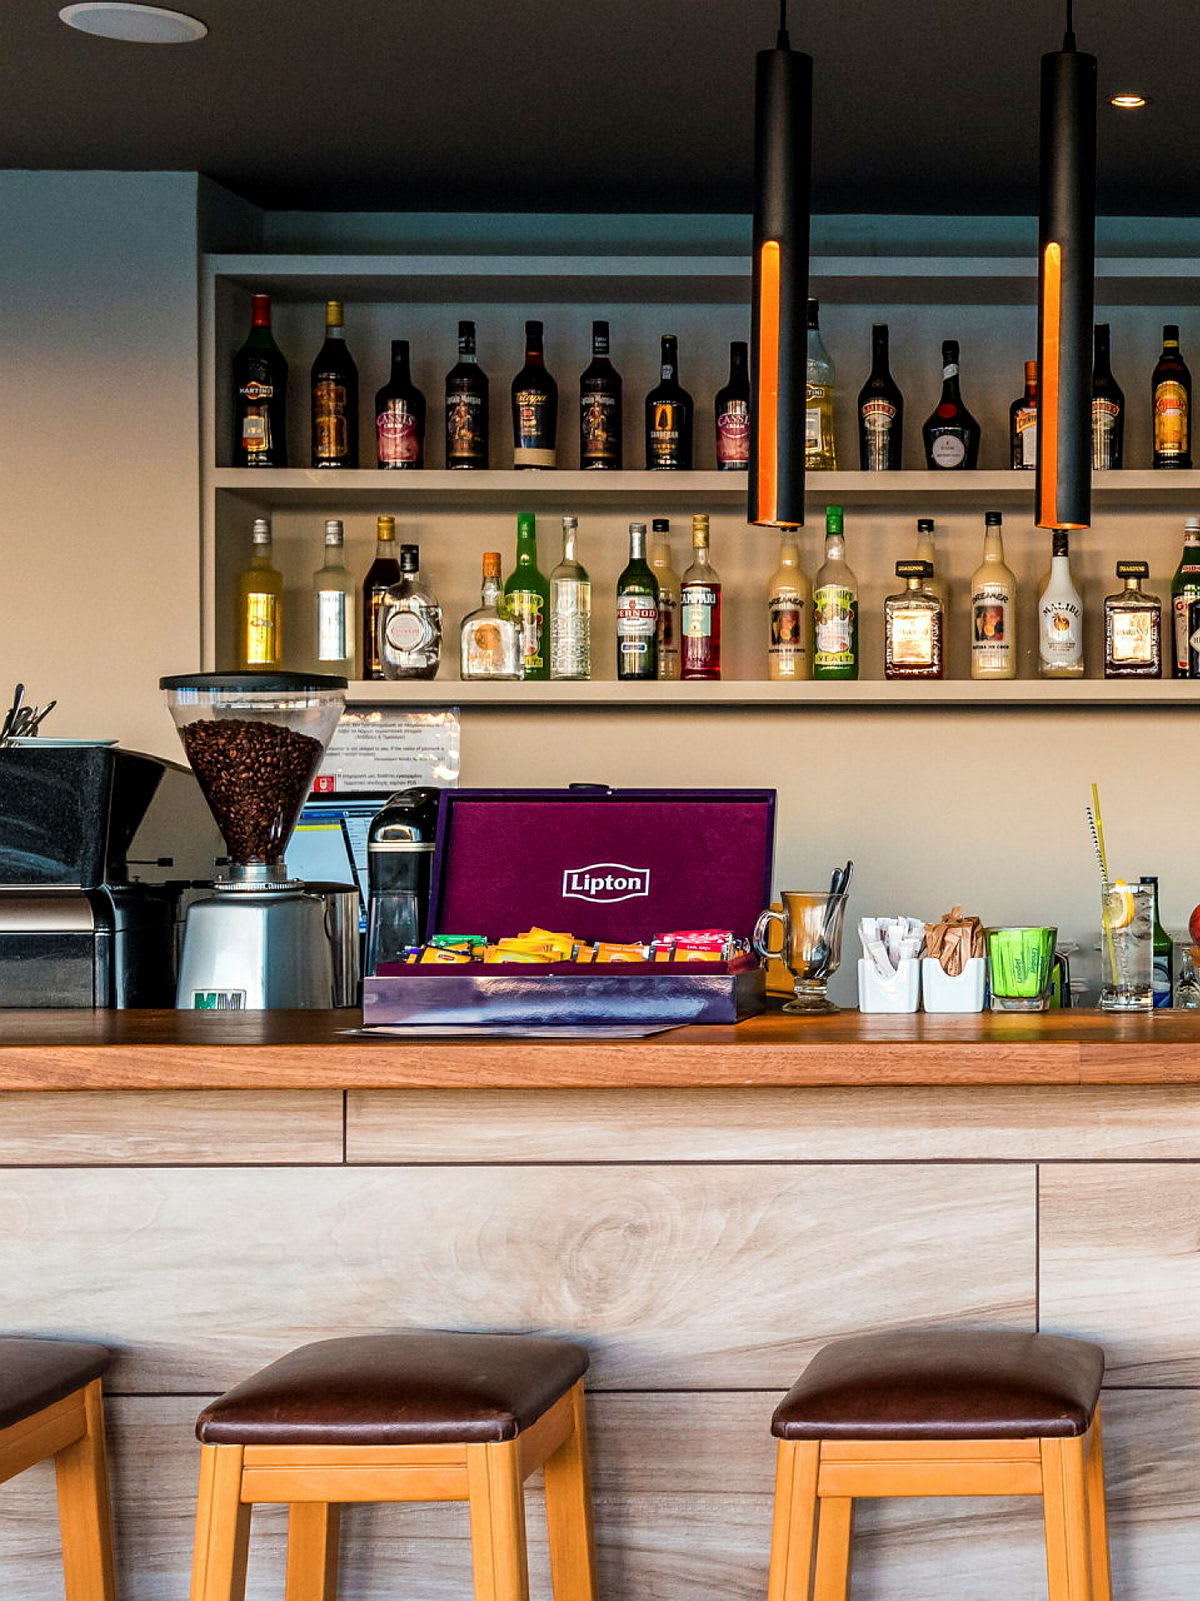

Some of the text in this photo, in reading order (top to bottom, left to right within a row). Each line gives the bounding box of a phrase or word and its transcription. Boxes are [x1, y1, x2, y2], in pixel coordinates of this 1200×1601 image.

[717, 413, 750, 427] CASSI
[618, 609, 655, 618] ERNOD
[571, 874, 641, 894] Lipton
